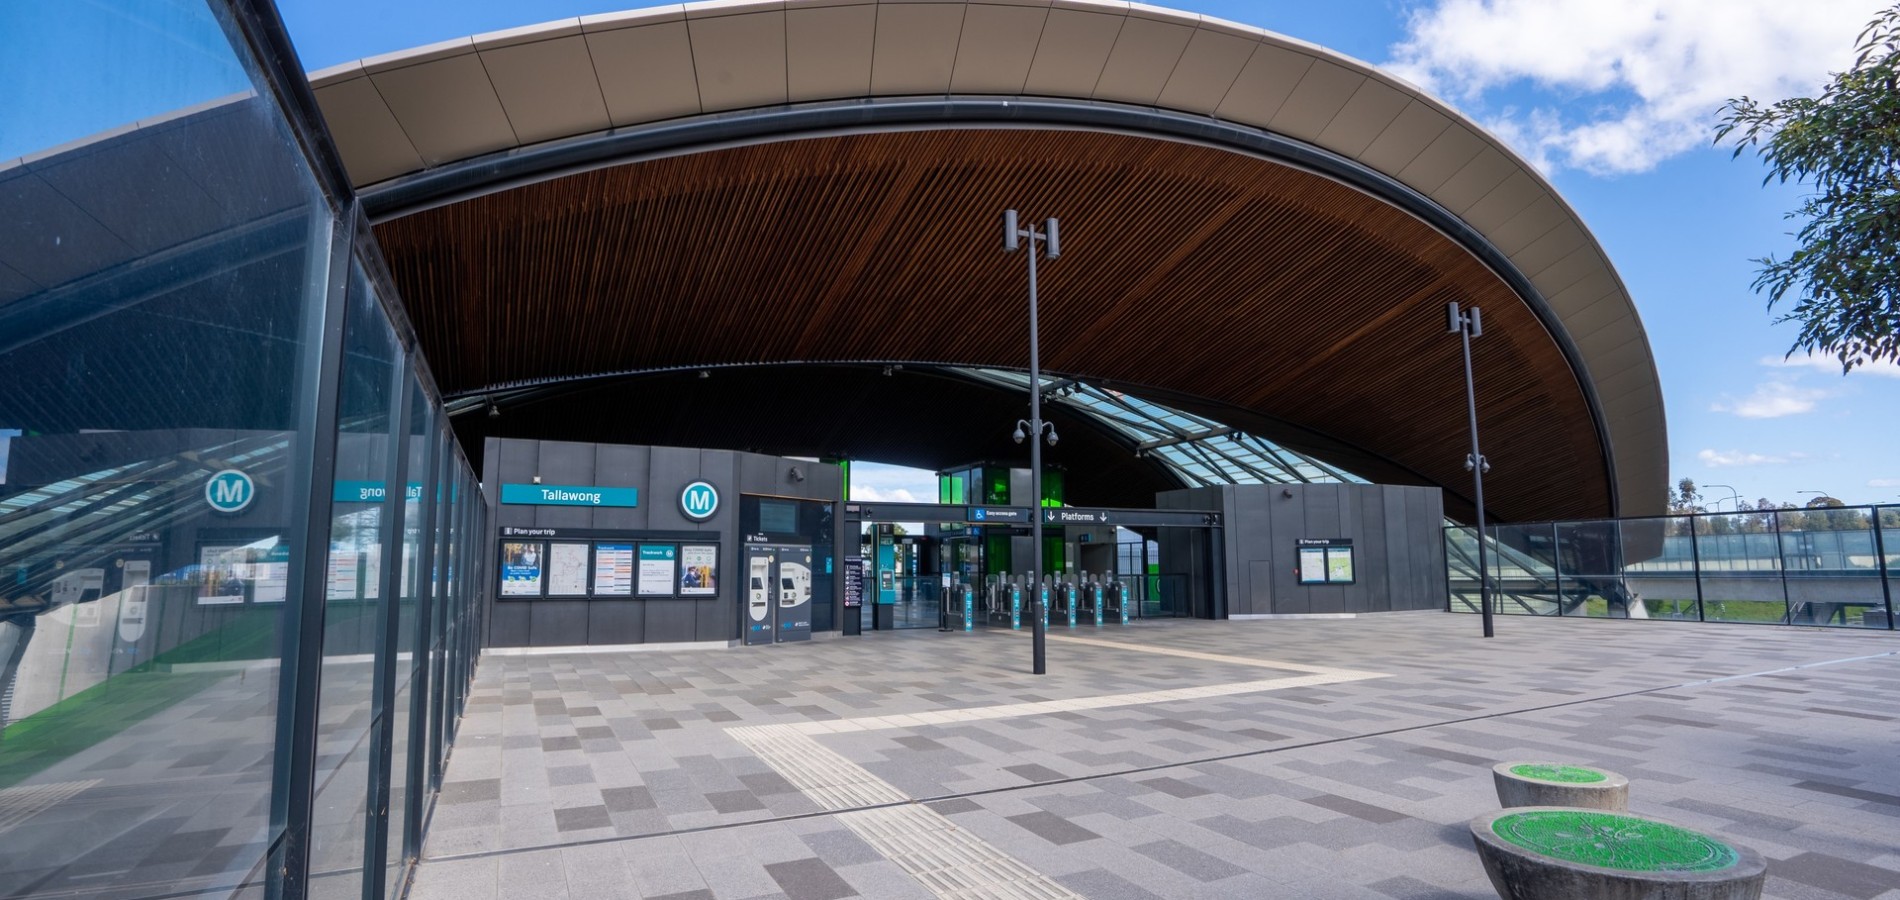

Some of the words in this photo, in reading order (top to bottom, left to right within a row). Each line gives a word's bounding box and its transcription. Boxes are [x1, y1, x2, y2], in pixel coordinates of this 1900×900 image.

[541, 489, 601, 504] Tallawong
[690, 490, 710, 510] M
[1061, 512, 1094, 521] Platforms
[513, 527, 528, 535] Plan
[543, 529, 556, 537] trip
[880, 537, 894, 545] HELP
